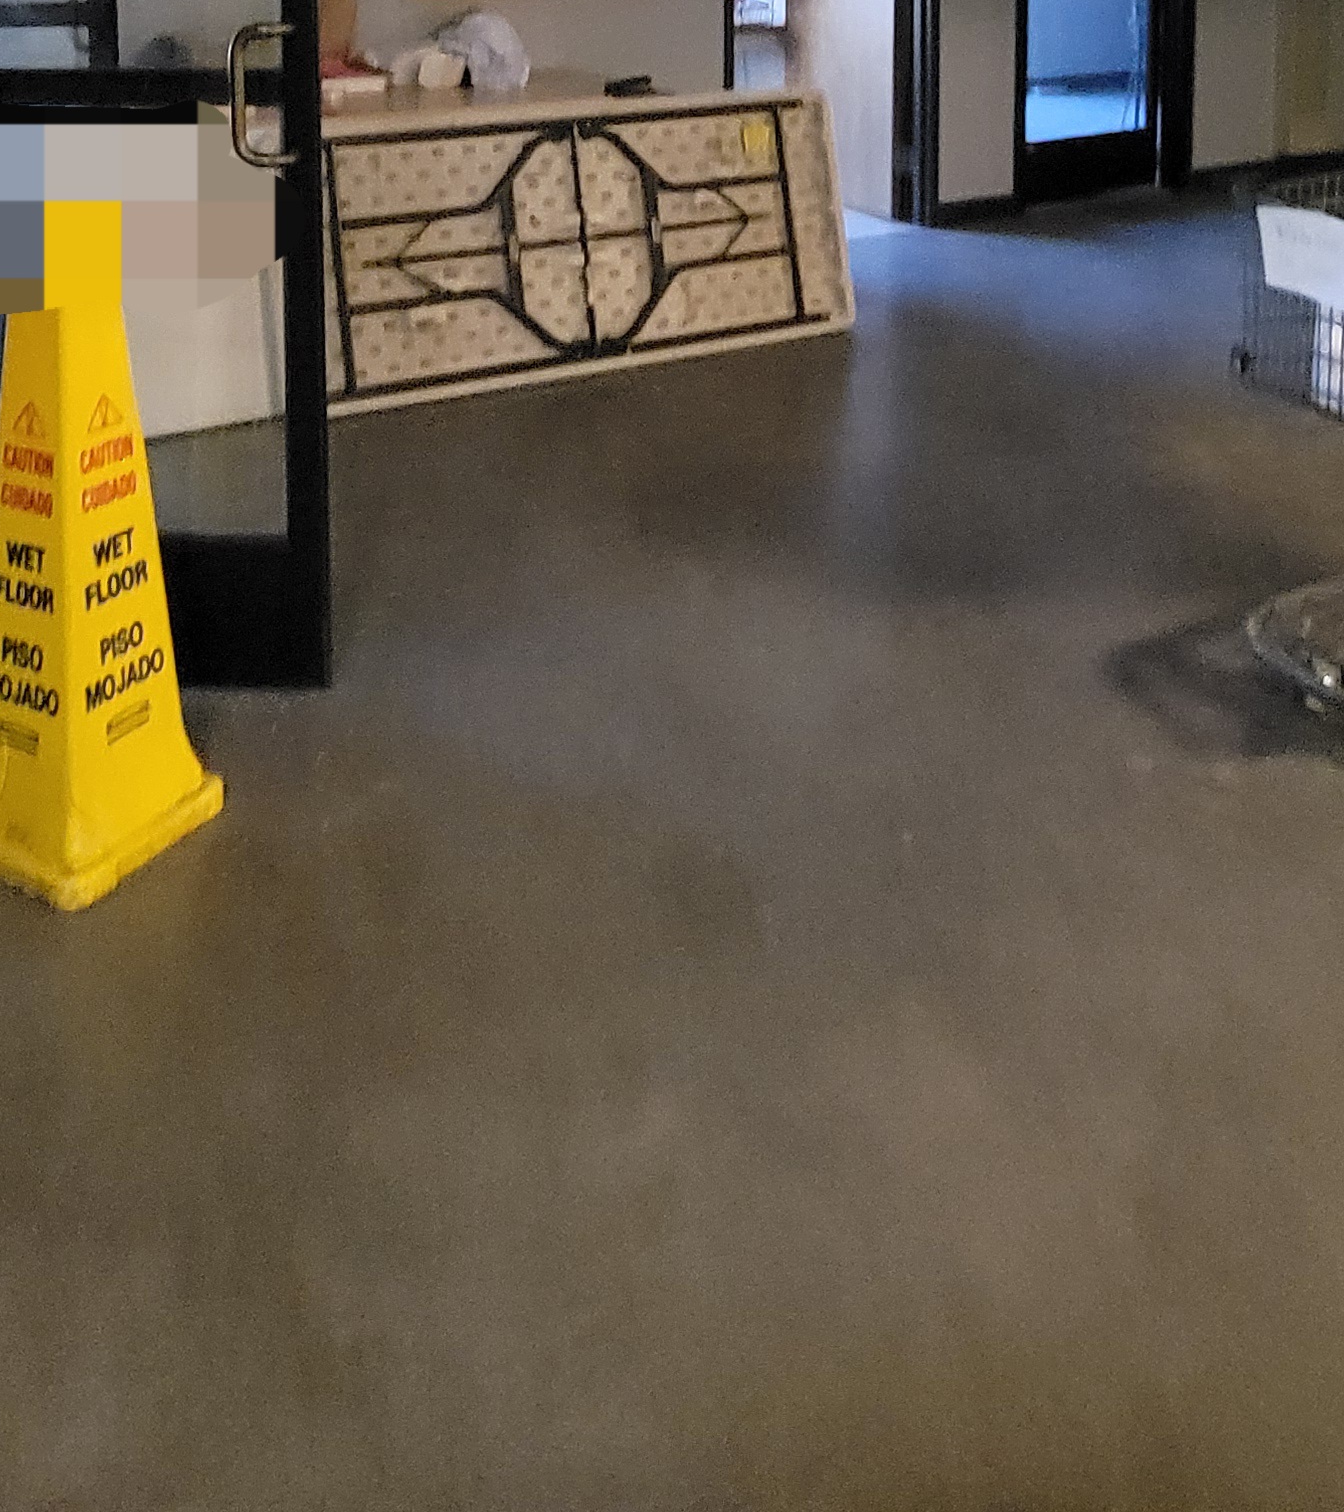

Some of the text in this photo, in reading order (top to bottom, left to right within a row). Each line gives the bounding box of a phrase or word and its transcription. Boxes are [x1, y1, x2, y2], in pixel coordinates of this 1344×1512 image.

[2, 441, 54, 479] CAUTION
[80, 433, 134, 475] CAUTION
[6, 540, 46, 573] WET
[93, 527, 134, 567] WET
[84, 559, 149, 612] FLOOR
[2, 631, 44, 672] PISO
[100, 621, 144, 666] PISO
[85, 648, 165, 714] MOJADO
